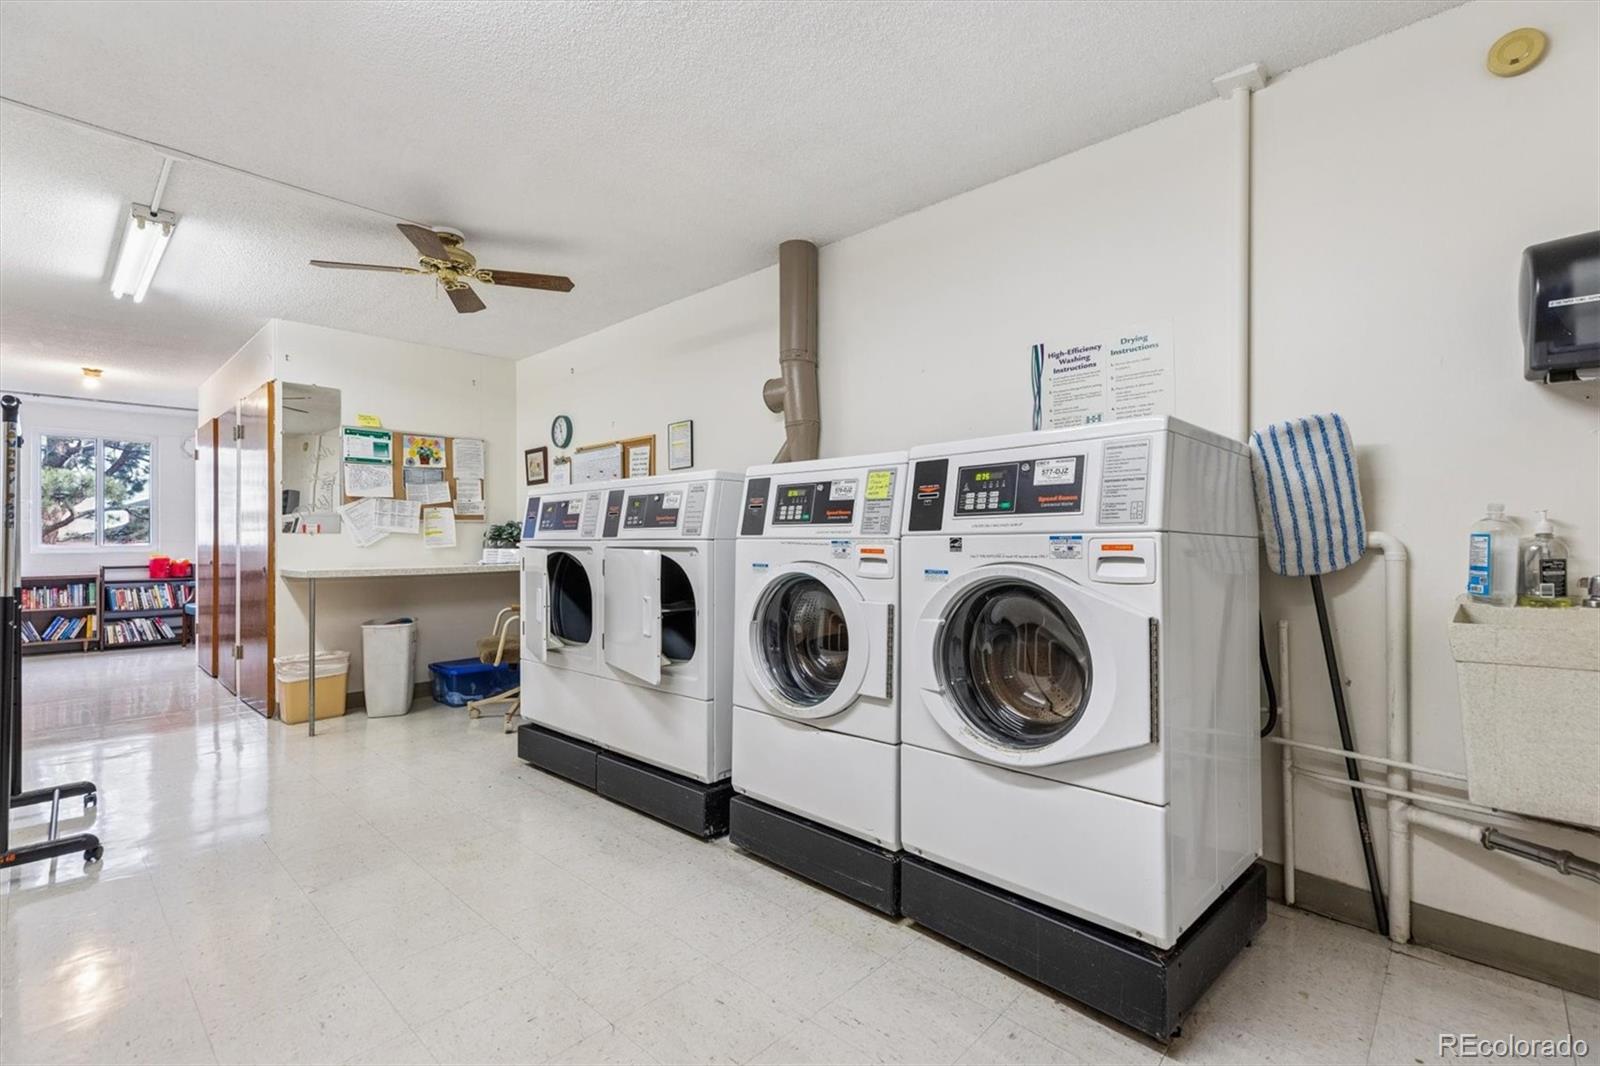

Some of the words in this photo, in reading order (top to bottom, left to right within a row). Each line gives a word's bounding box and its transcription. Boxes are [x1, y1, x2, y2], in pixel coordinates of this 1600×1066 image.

[1120, 334, 1149, 346] Drying
[1047, 343, 1102, 360] High-Efficiency
[1110, 342, 1159, 357] Instructions
[1058, 354, 1091, 366] Washing
[1053, 362, 1097, 375] Instructions
